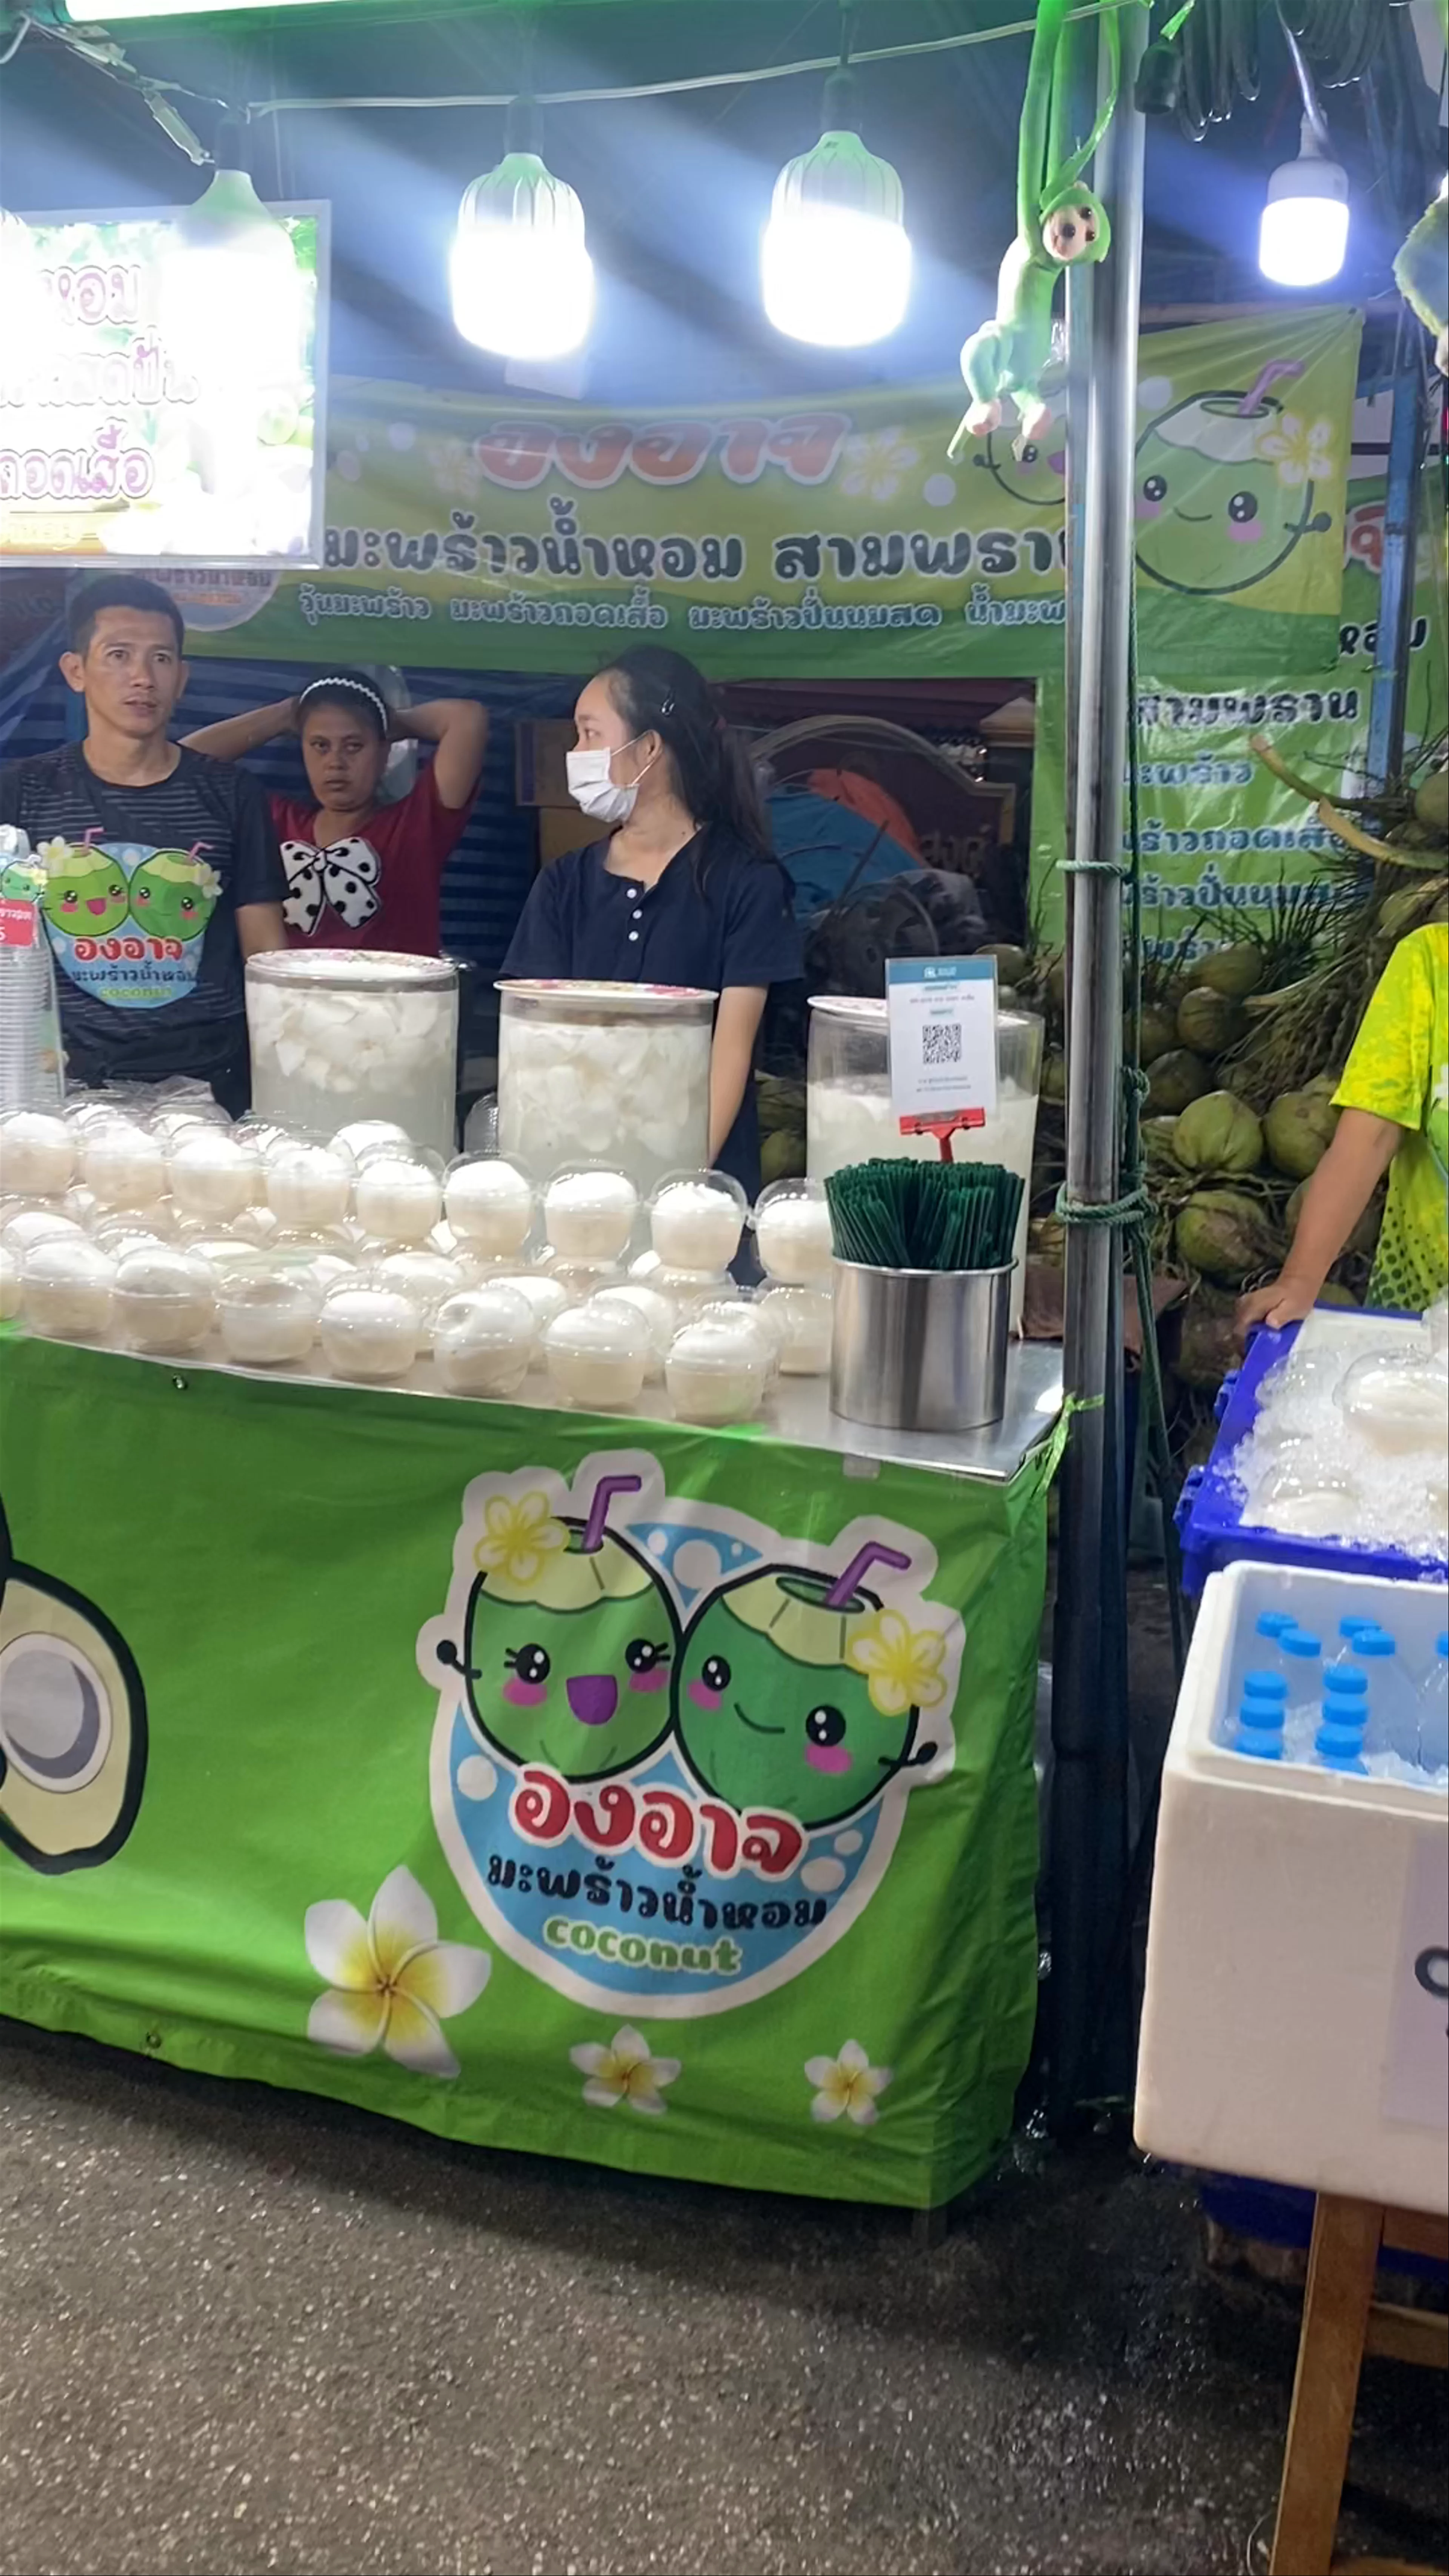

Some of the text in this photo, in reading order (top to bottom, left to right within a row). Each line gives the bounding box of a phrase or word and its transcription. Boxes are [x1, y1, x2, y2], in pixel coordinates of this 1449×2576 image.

[475, 415, 848, 487] องอาจ
[326, 497, 1066, 579] มะพร้าวน้ำหอม สามพรา
[299, 583, 431, 625] วุ้นมะพร้าว
[688, 586, 942, 629] มะพร้าวปั่นนมสด
[73, 937, 184, 961] องอาจ
[513, 1770, 804, 1875] องอาจ
[488, 1855, 828, 1930] มะพร้าวน้ำหอม
[545, 1918, 741, 1973] coconut
